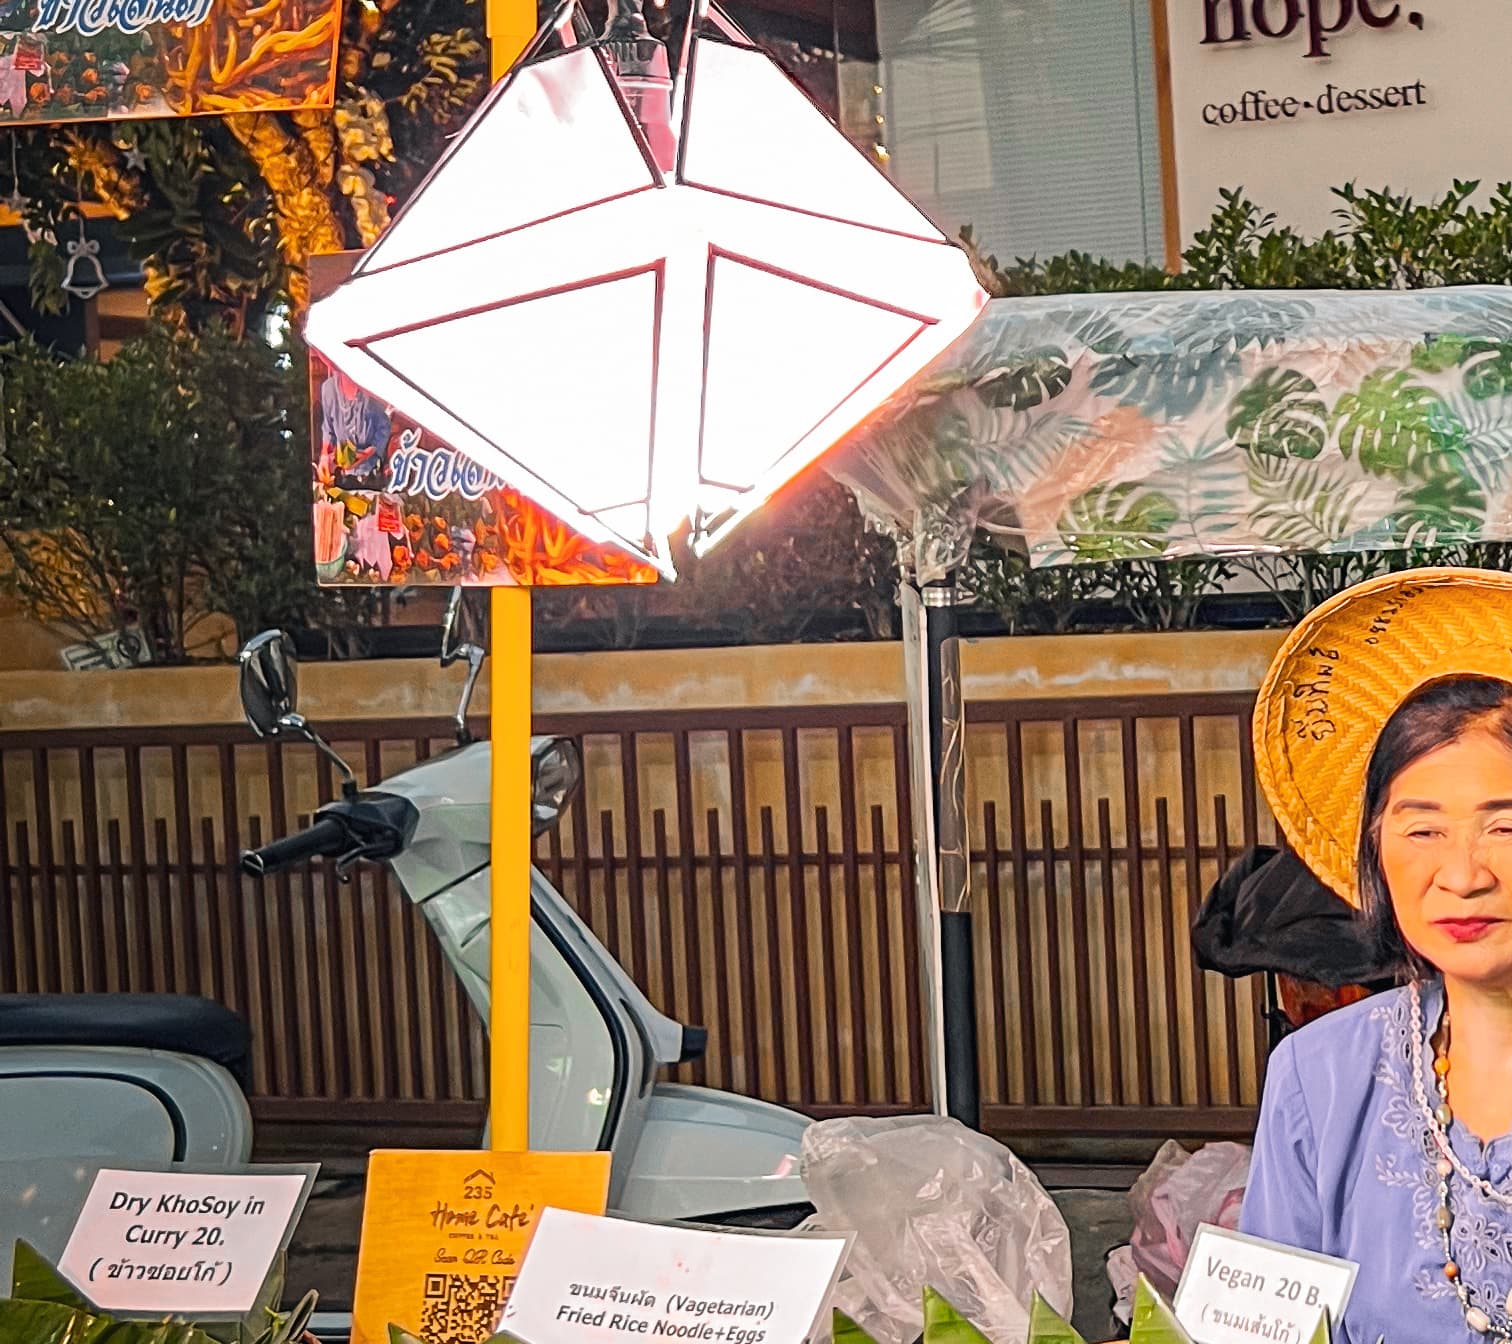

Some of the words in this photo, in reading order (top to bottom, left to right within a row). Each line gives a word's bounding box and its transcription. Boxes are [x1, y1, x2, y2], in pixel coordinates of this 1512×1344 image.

[109, 1192, 151, 1216] Dry
[155, 1194, 241, 1218] KhoSoy
[244, 1196, 265, 1215] in
[463, 1185, 493, 1200] 235
[125, 1224, 188, 1249] Curry
[192, 1226, 225, 1246] 20.
[1206, 1255, 1266, 1292] Vegan
[1274, 1277, 1301, 1301] 20
[556, 1305, 603, 1329] Fried
[609, 1314, 649, 1334] Rice
[666, 1293, 775, 1321] (Vagetarian)
